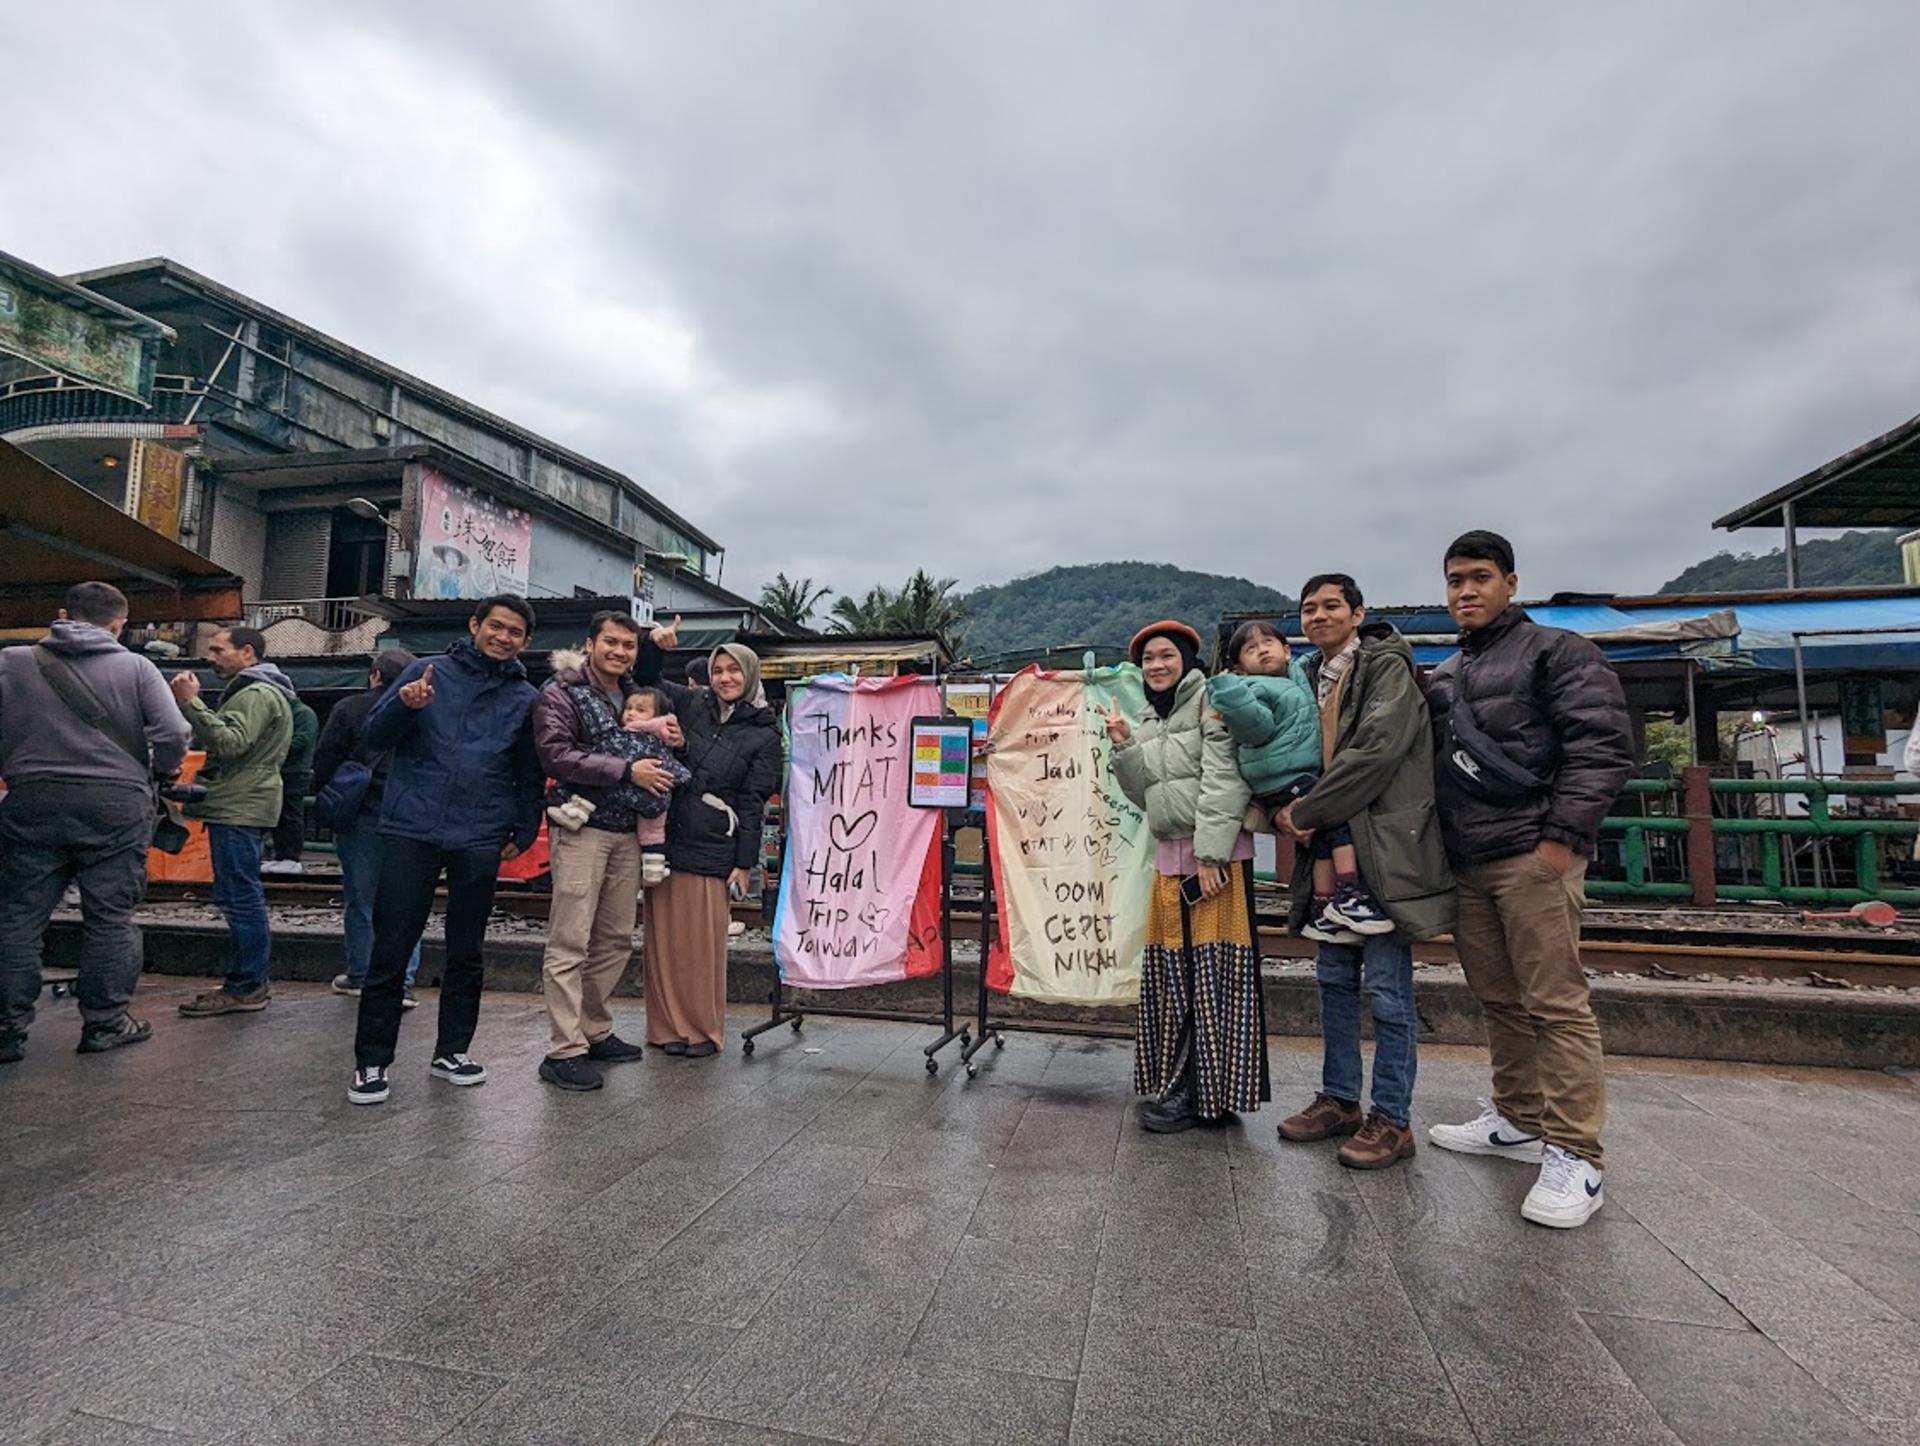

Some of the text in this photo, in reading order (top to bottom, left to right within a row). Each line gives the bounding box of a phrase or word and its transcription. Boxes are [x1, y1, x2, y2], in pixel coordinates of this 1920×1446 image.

[804, 711, 897, 752] Thanks
[806, 847, 887, 895] Halal
[806, 899, 850, 938] Trip
[796, 929, 878, 957] Taiwan
